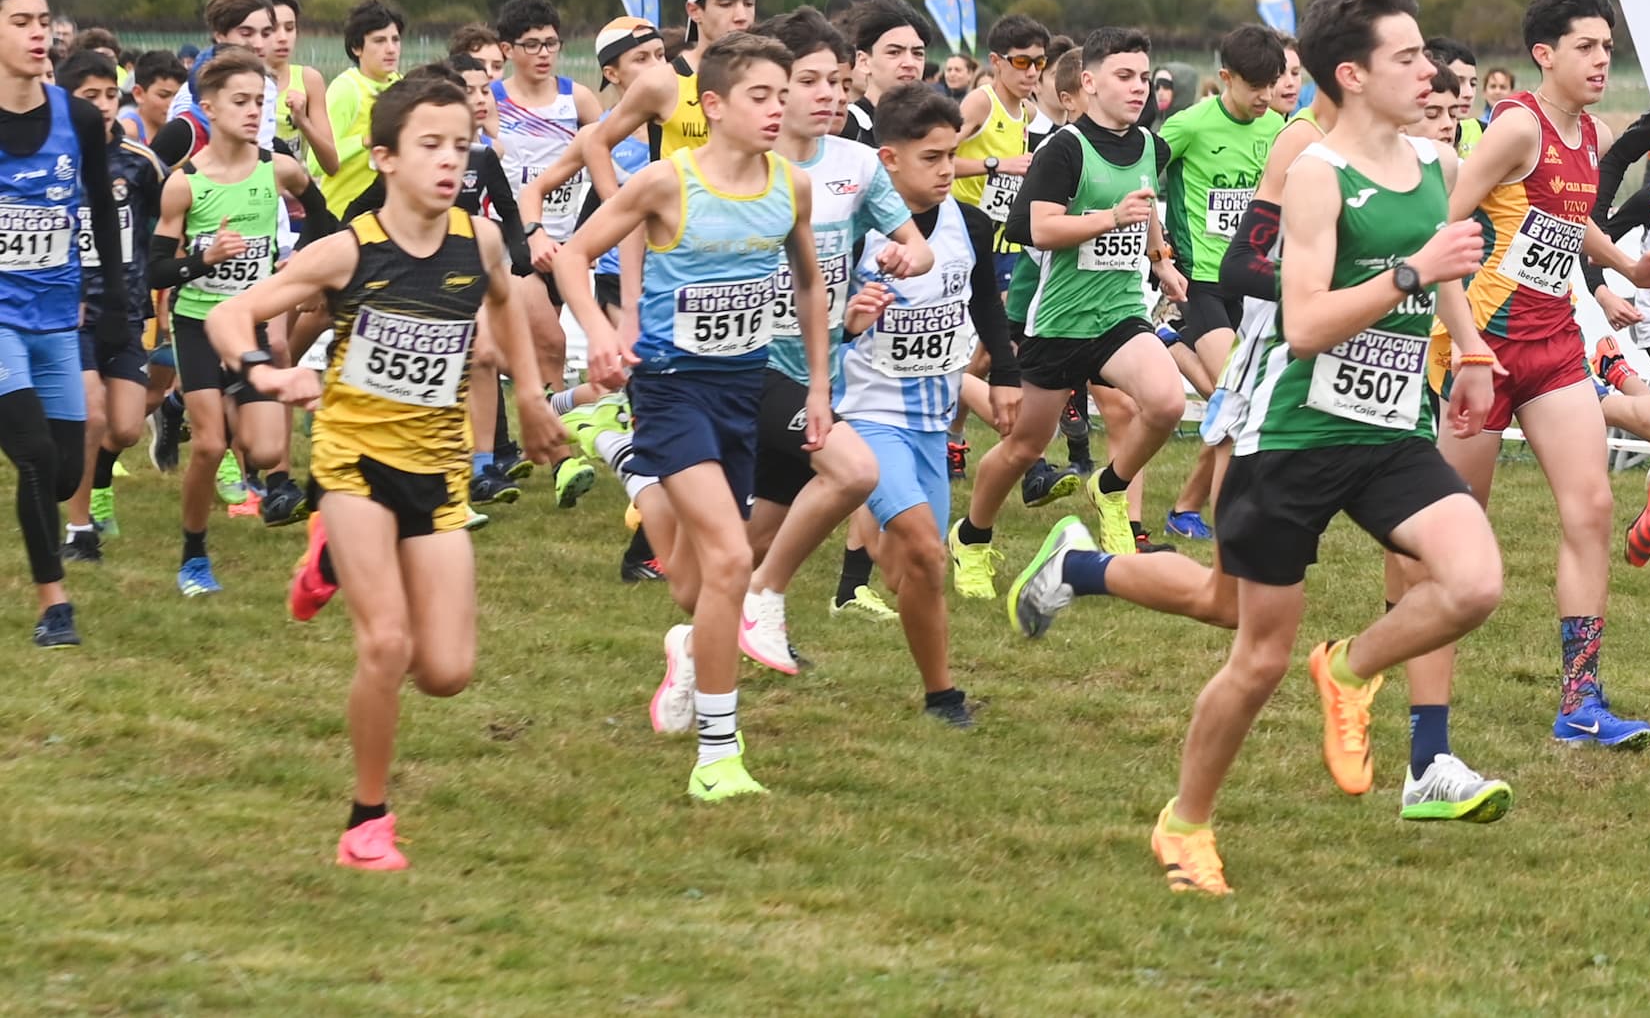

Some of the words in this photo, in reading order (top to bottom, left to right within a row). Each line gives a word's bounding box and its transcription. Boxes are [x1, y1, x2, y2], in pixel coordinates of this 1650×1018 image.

[1563, 200, 1588, 213] VINO
[1093, 235, 1142, 256] 5555
[1522, 244, 1574, 280] 5470
[685, 289, 773, 312] BURGOS
[694, 308, 763, 342] 5516
[883, 312, 962, 333] BURGOS
[363, 327, 463, 354] BURGOS
[891, 331, 955, 361] 5487
[367, 346, 448, 386] 5532
[1331, 339, 1419, 373] BURGOS
[1333, 362, 1409, 405] 5507
